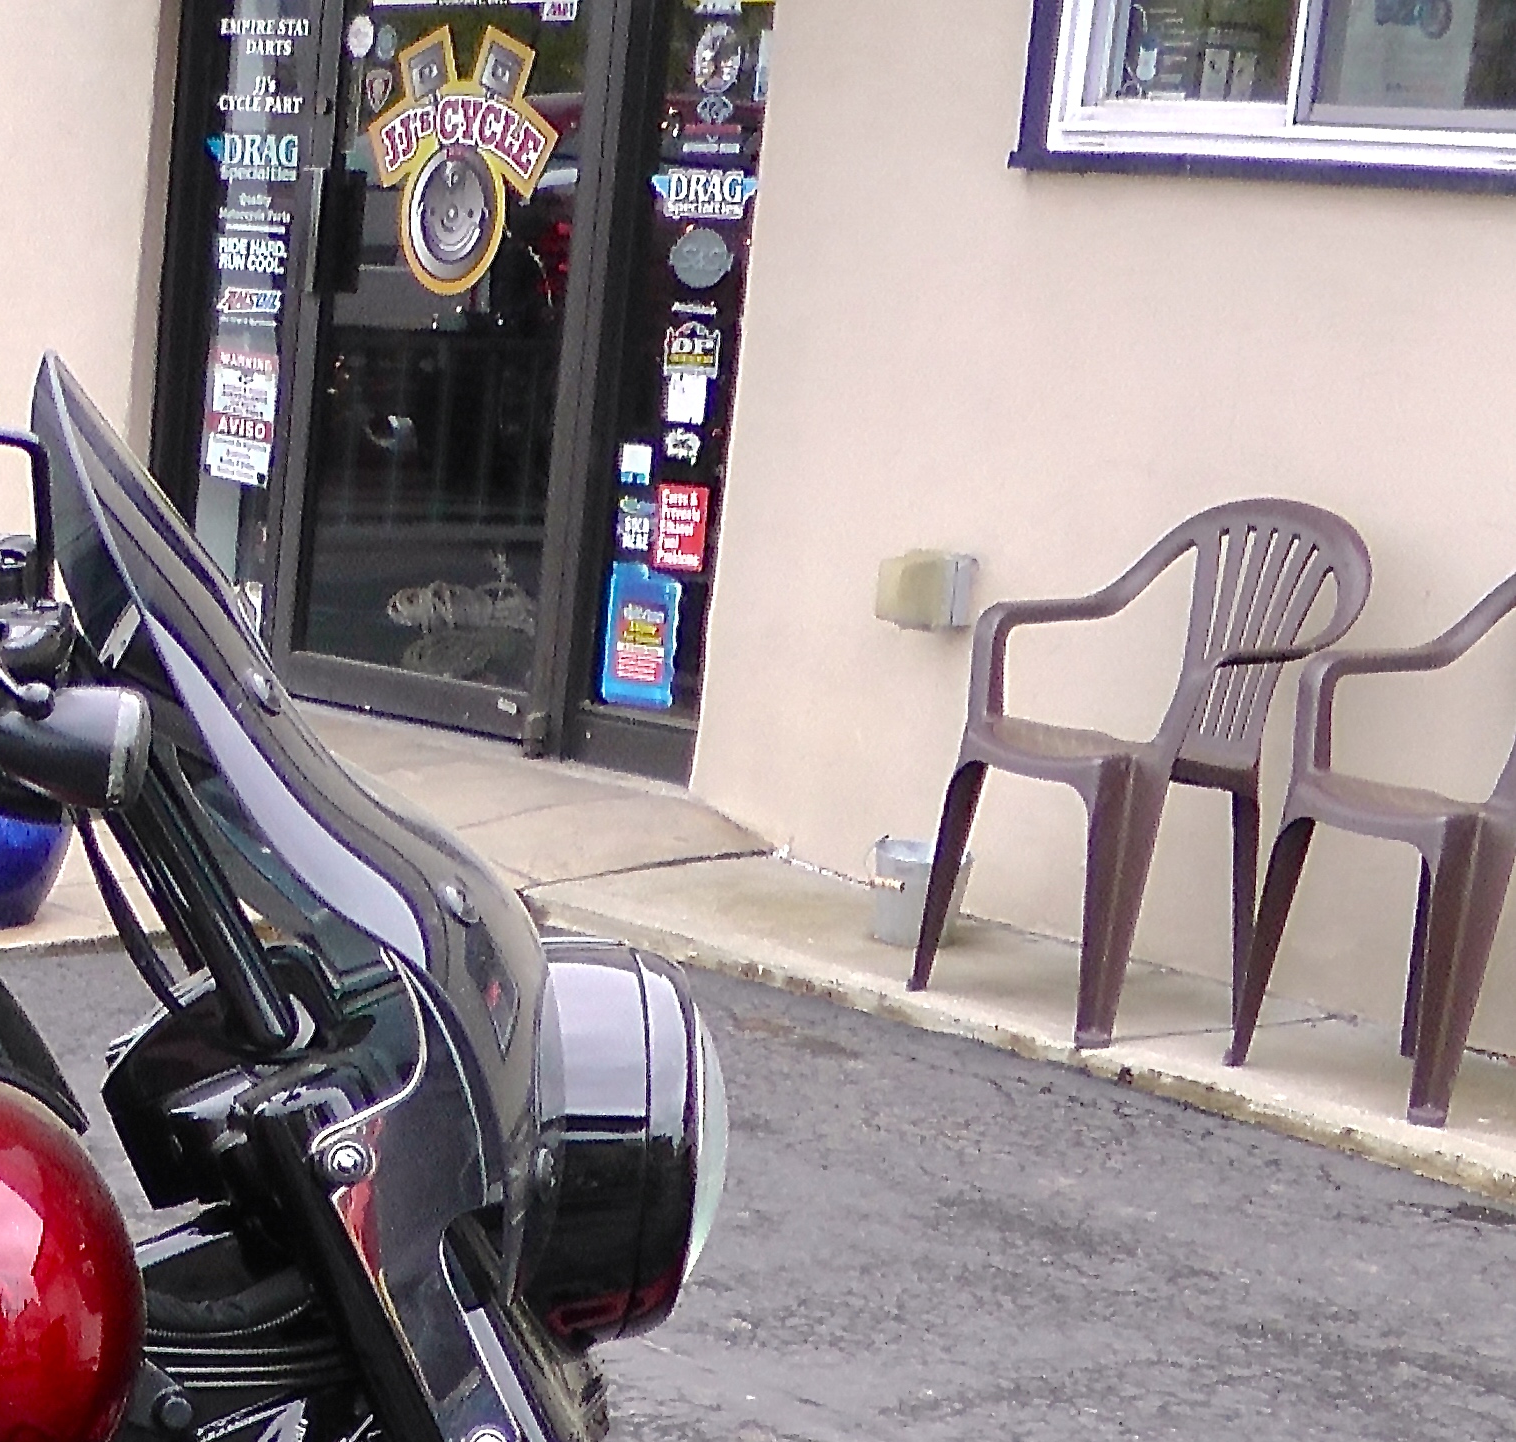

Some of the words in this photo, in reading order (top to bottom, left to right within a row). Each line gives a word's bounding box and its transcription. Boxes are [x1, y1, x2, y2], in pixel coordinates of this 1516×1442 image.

[220, 18, 276, 36] EMPIRE
[245, 39, 293, 56] DARTS
[218, 95, 262, 112] CYCLE
[436, 95, 547, 180] CYCLE
[223, 133, 299, 168] DRAG
[667, 168, 744, 203] DRAG
[666, 201, 744, 219] Specialties
[218, 237, 248, 254] RIDE
[218, 253, 246, 270] RUN
[219, 351, 274, 372] WARNING
[216, 415, 267, 440] AVISO
